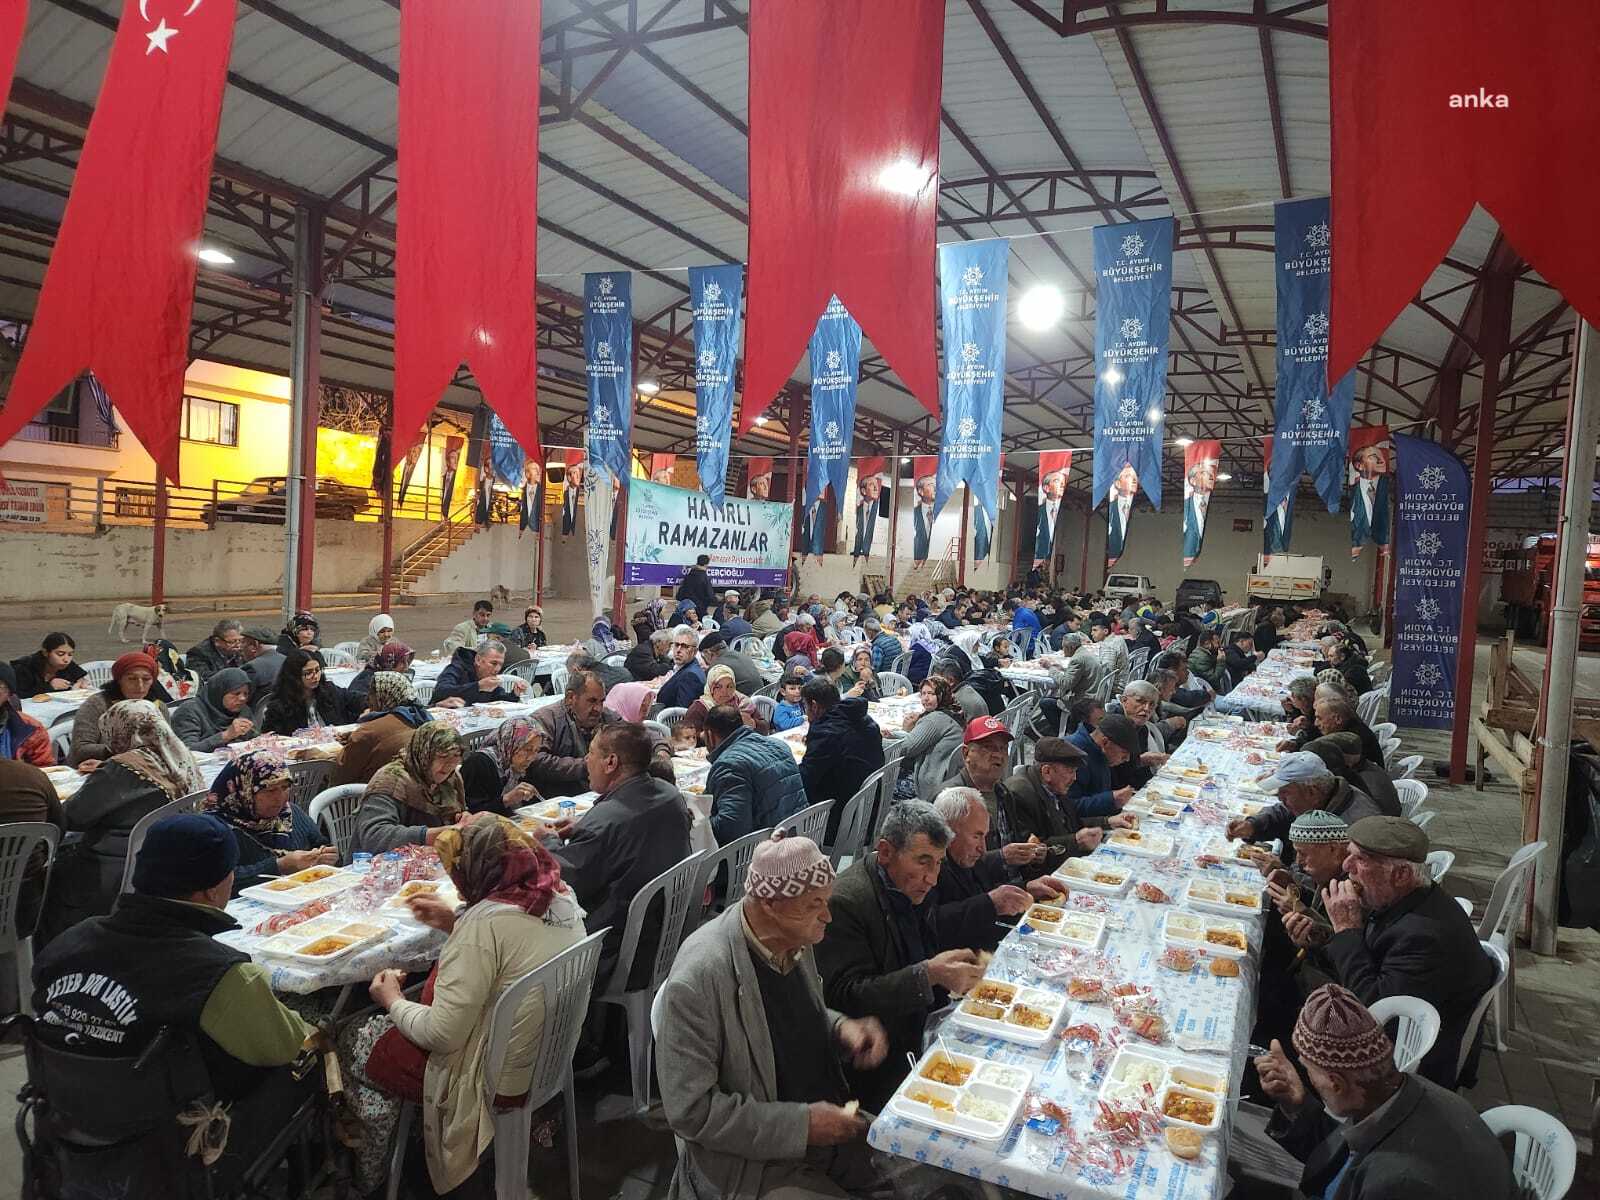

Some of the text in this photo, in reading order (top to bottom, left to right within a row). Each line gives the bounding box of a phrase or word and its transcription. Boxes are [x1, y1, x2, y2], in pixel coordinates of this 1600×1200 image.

[1103, 263, 1163, 277] BÜYÜKŞEHİR
[1103, 347, 1159, 358] BÜYÜKŞEHİR
[1102, 427, 1155, 436] BÜYÜKŞEHİR
[1281, 429, 1340, 440] BÜYÜKŞEHİR
[658, 521, 769, 553] RAMAZANLAR
[100, 980, 138, 1026] LASTİK
